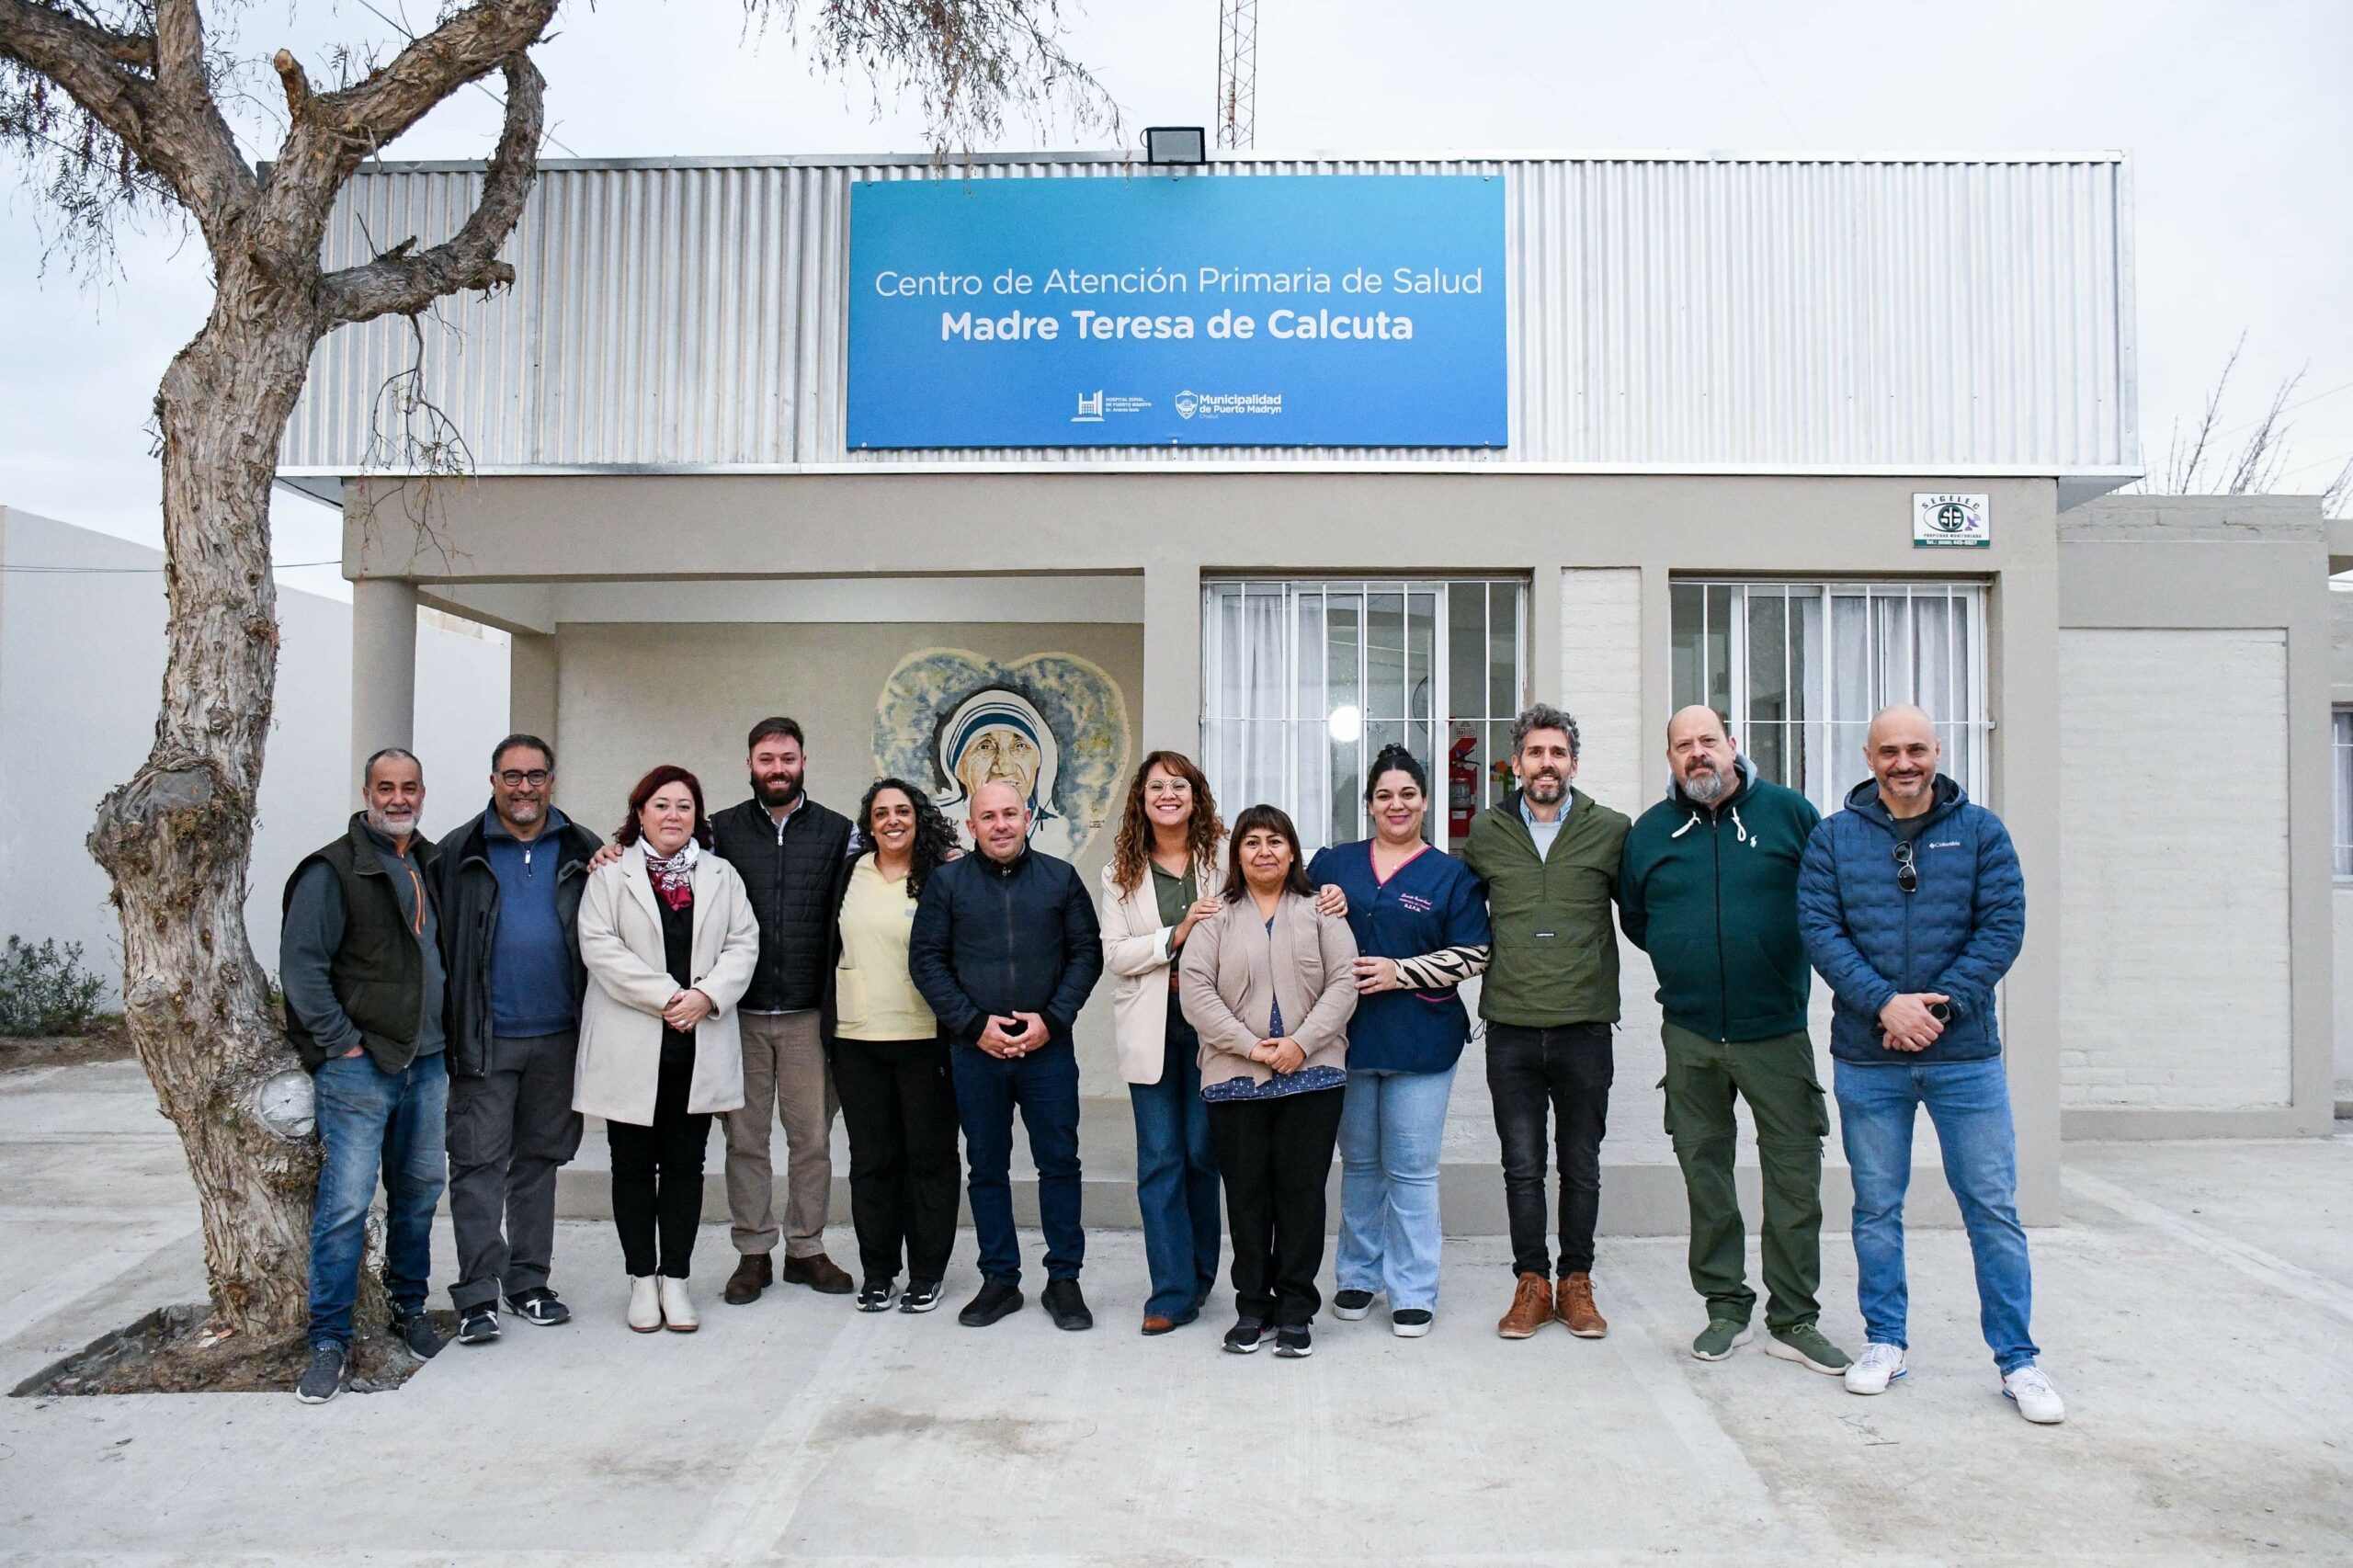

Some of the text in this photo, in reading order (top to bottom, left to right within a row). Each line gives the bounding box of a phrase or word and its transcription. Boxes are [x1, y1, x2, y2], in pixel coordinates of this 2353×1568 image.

[875, 267, 1483, 297] Centro de Atención Primaria de Salud
[941, 308, 1414, 341] Madre Teresa de Calcuta
[1199, 393, 1282, 406] Municipalidad
[1199, 404, 1282, 415] de Puerto Madryn
[1922, 495, 1980, 510] SEGELEC
